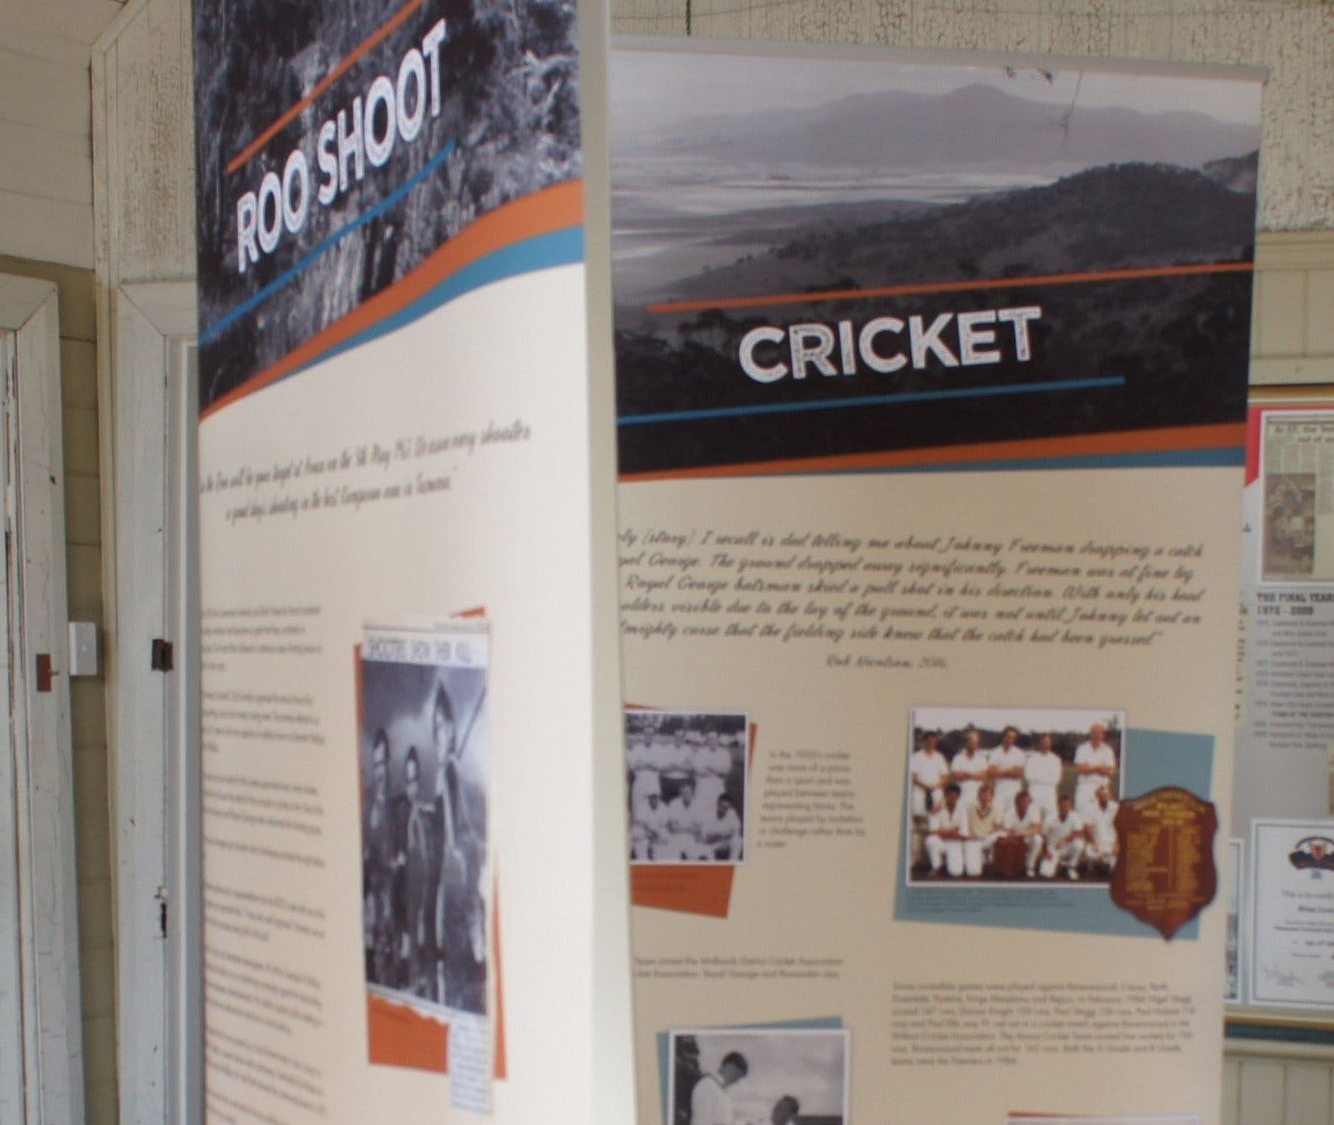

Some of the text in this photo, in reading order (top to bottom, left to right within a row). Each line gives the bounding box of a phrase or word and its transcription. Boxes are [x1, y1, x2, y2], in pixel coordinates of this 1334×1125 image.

[237, 18, 447, 273] ROO SHOOT
[738, 305, 1042, 383] CRICKET
[869, 539, 891, 550] me
[711, 552, 735, 567] The
[1256, 592, 1276, 604] THE
[1279, 592, 1307, 604] FINAL
[776, 600, 799, 615] the
[854, 601, 876, 616] the
[724, 622, 757, 638] that
[759, 622, 782, 638] the
[927, 625, 959, 641] that
[961, 626, 984, 642] the
